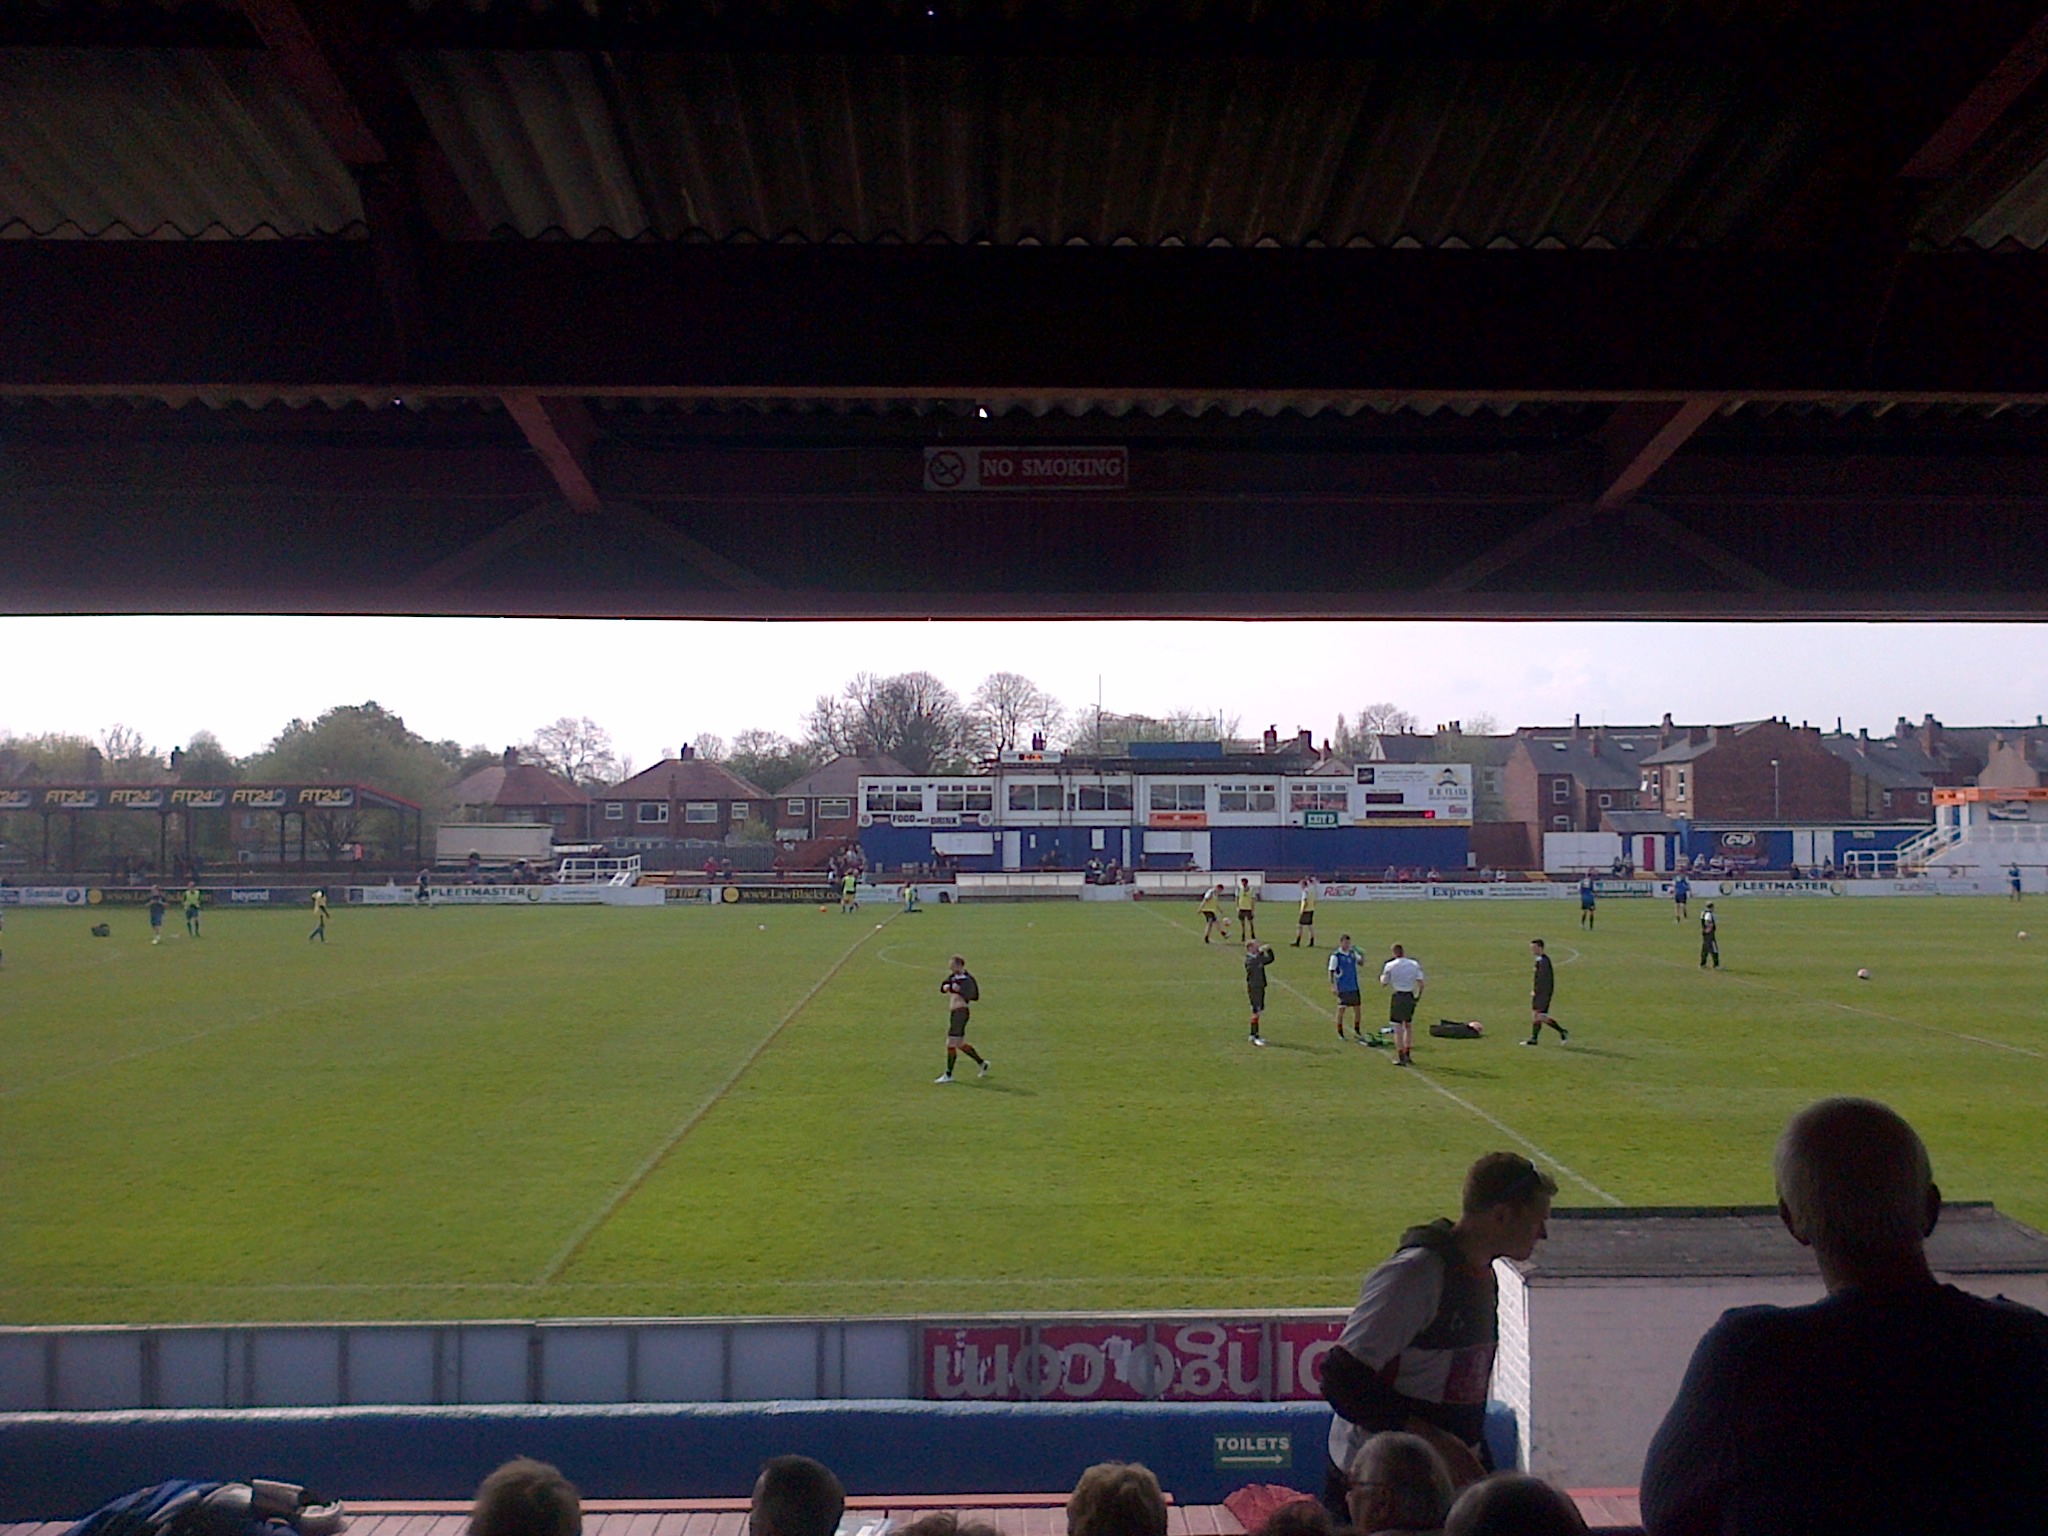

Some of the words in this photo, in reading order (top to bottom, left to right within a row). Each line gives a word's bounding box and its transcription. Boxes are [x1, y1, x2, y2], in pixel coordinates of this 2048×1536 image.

[982, 459, 1013, 477] NO
[1021, 458, 1122, 477] SMOKING
[45, 790, 87, 804] FIT24
[108, 790, 152, 804] FIT24
[170, 789, 213, 804] FIT24
[231, 789, 275, 804] FIT24
[298, 788, 342, 804] FIT24
[892, 814, 916, 823] FOOD
[930, 816, 958, 825] DRINK
[431, 887, 526, 897] FLEETMASTER
[1432, 886, 1484, 899] Express
[1735, 881, 1829, 890] FLEETMASTER
[231, 889, 269, 902] beyond
[1215, 1437, 1290, 1451] TOILETS
